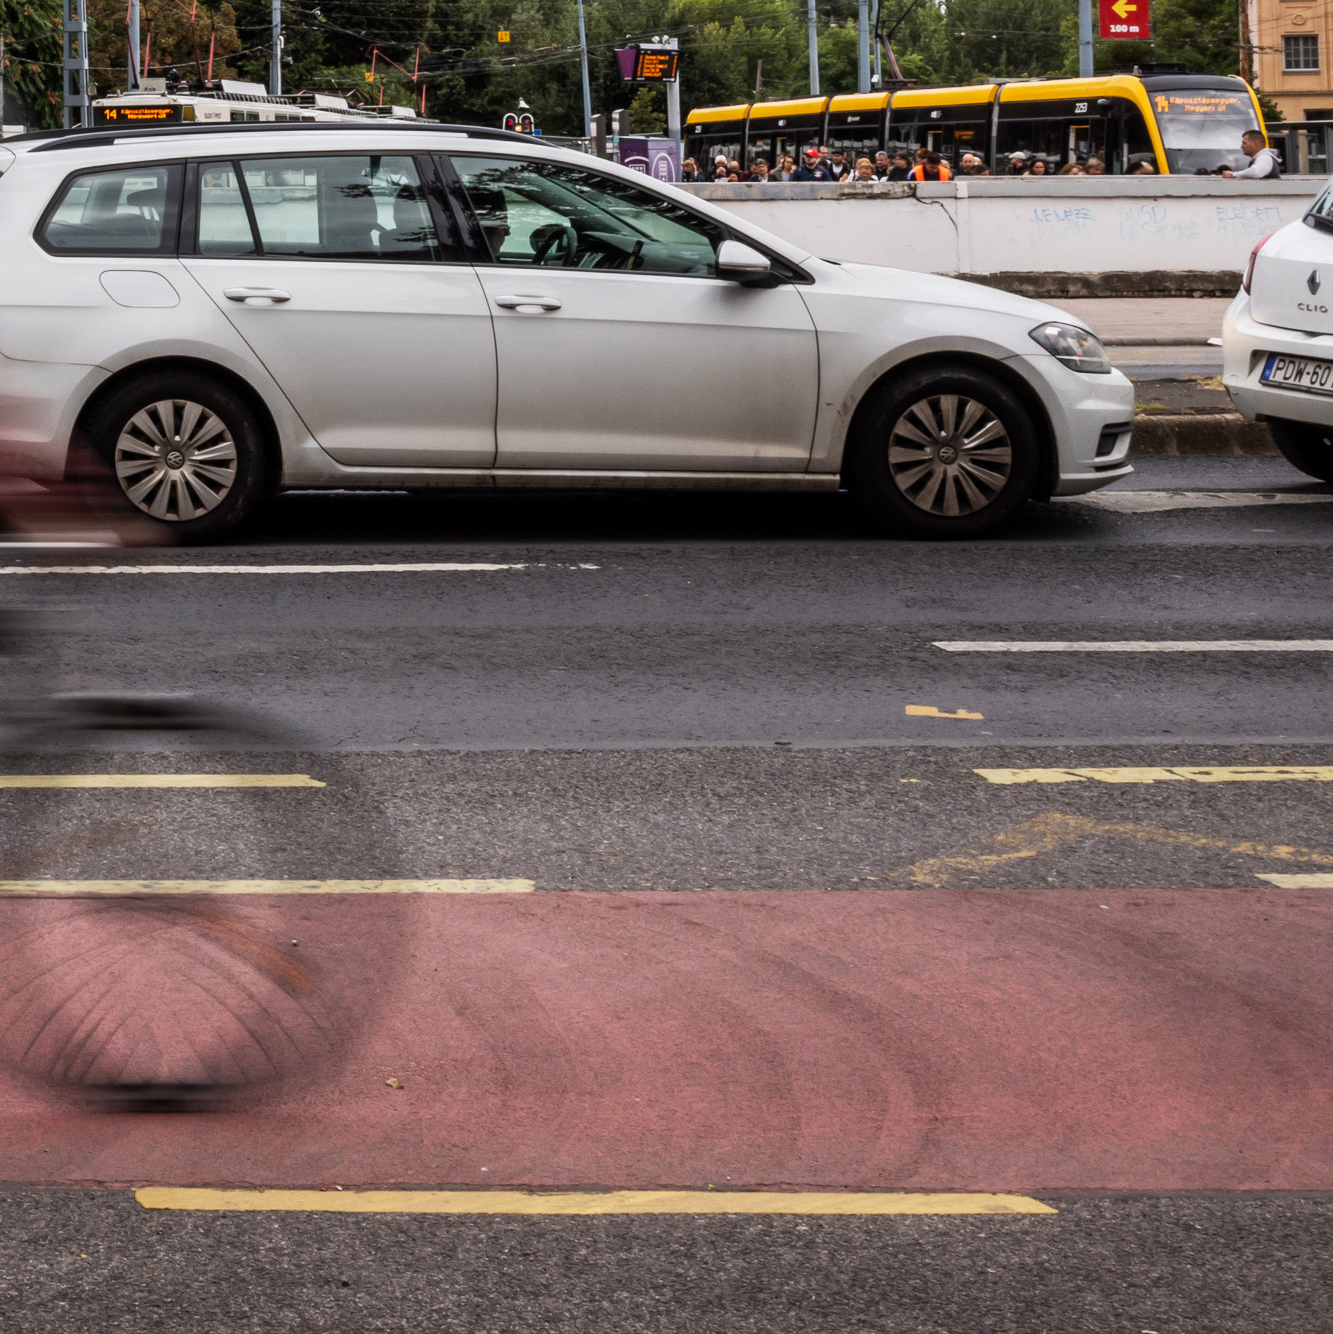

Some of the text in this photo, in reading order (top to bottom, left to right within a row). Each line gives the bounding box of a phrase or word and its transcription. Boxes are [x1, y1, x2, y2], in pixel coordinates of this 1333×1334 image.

[1109, 24, 1140, 33] 100 m
[1154, 95, 1169, 113] 14
[103, 108, 117, 120] 14
[1297, 302, 1329, 314] CLIO
[1272, 358, 1333, 389] PDW-60
